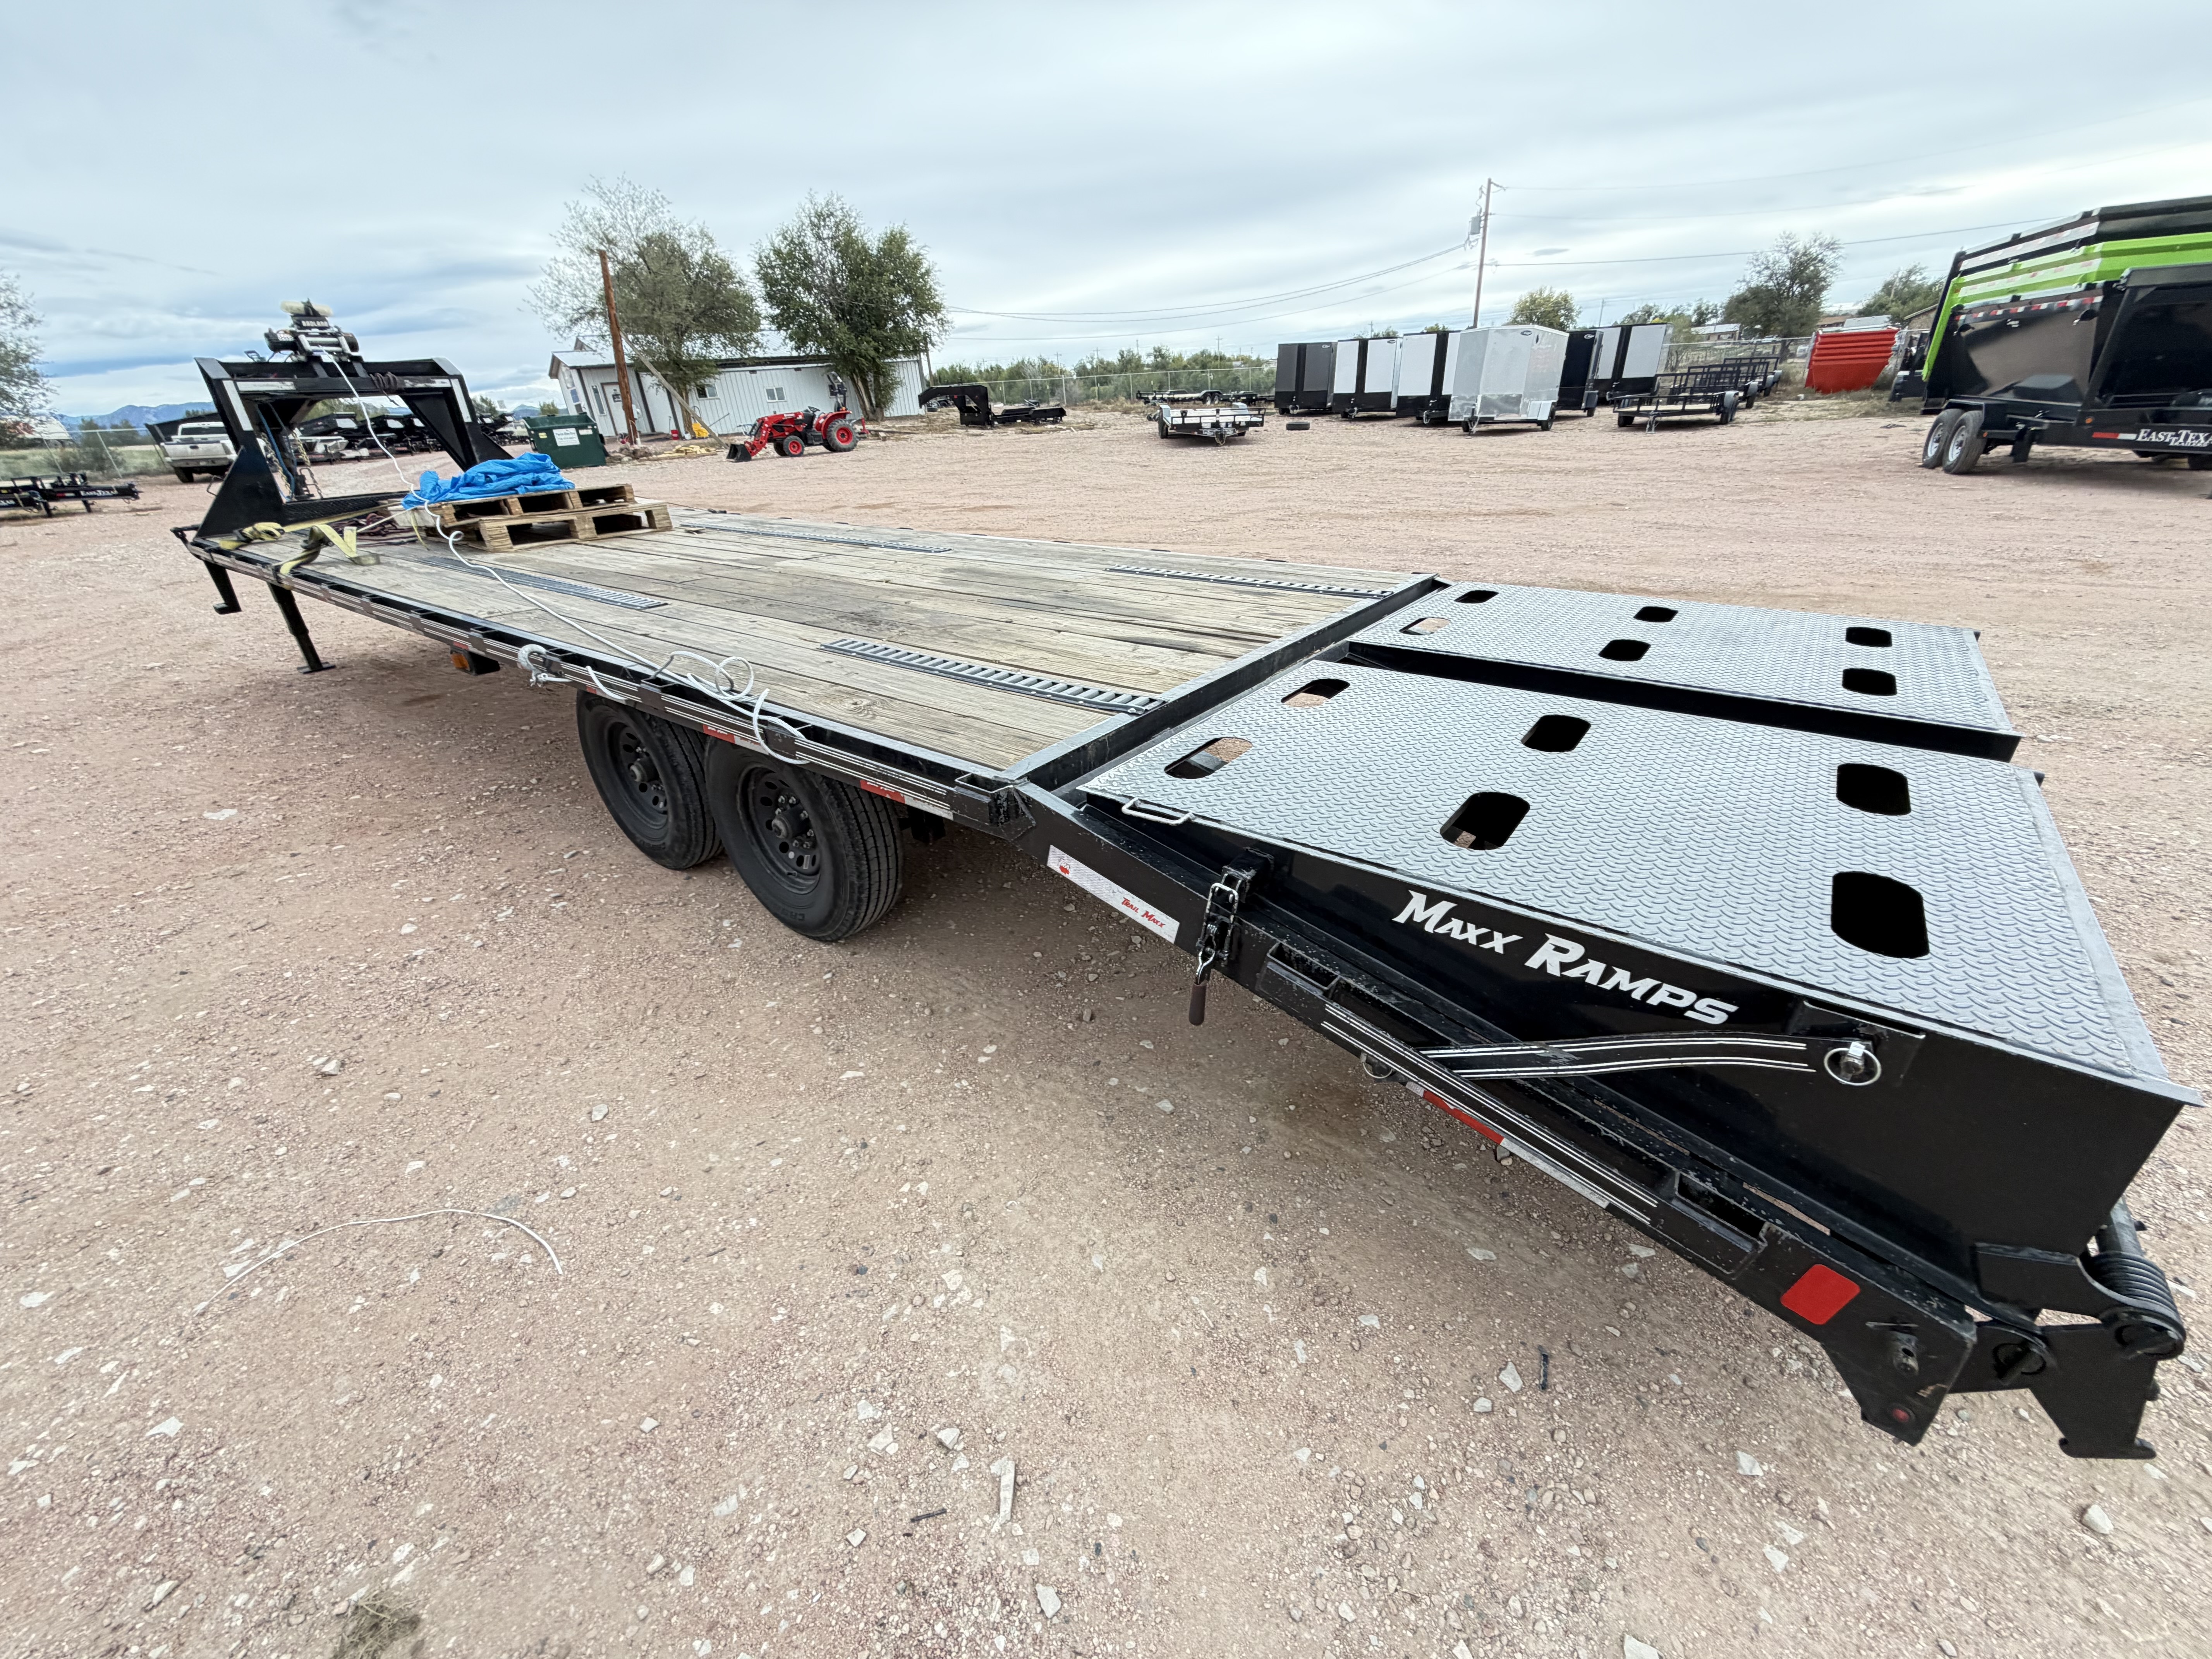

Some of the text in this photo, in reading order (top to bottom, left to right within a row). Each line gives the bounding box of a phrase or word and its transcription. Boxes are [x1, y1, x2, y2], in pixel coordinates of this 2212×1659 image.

[2136, 429, 2176, 442] EAST
[1121, 897, 1139, 913] TRAIL
[1392, 890, 1739, 1025] MAXX RAMPS
